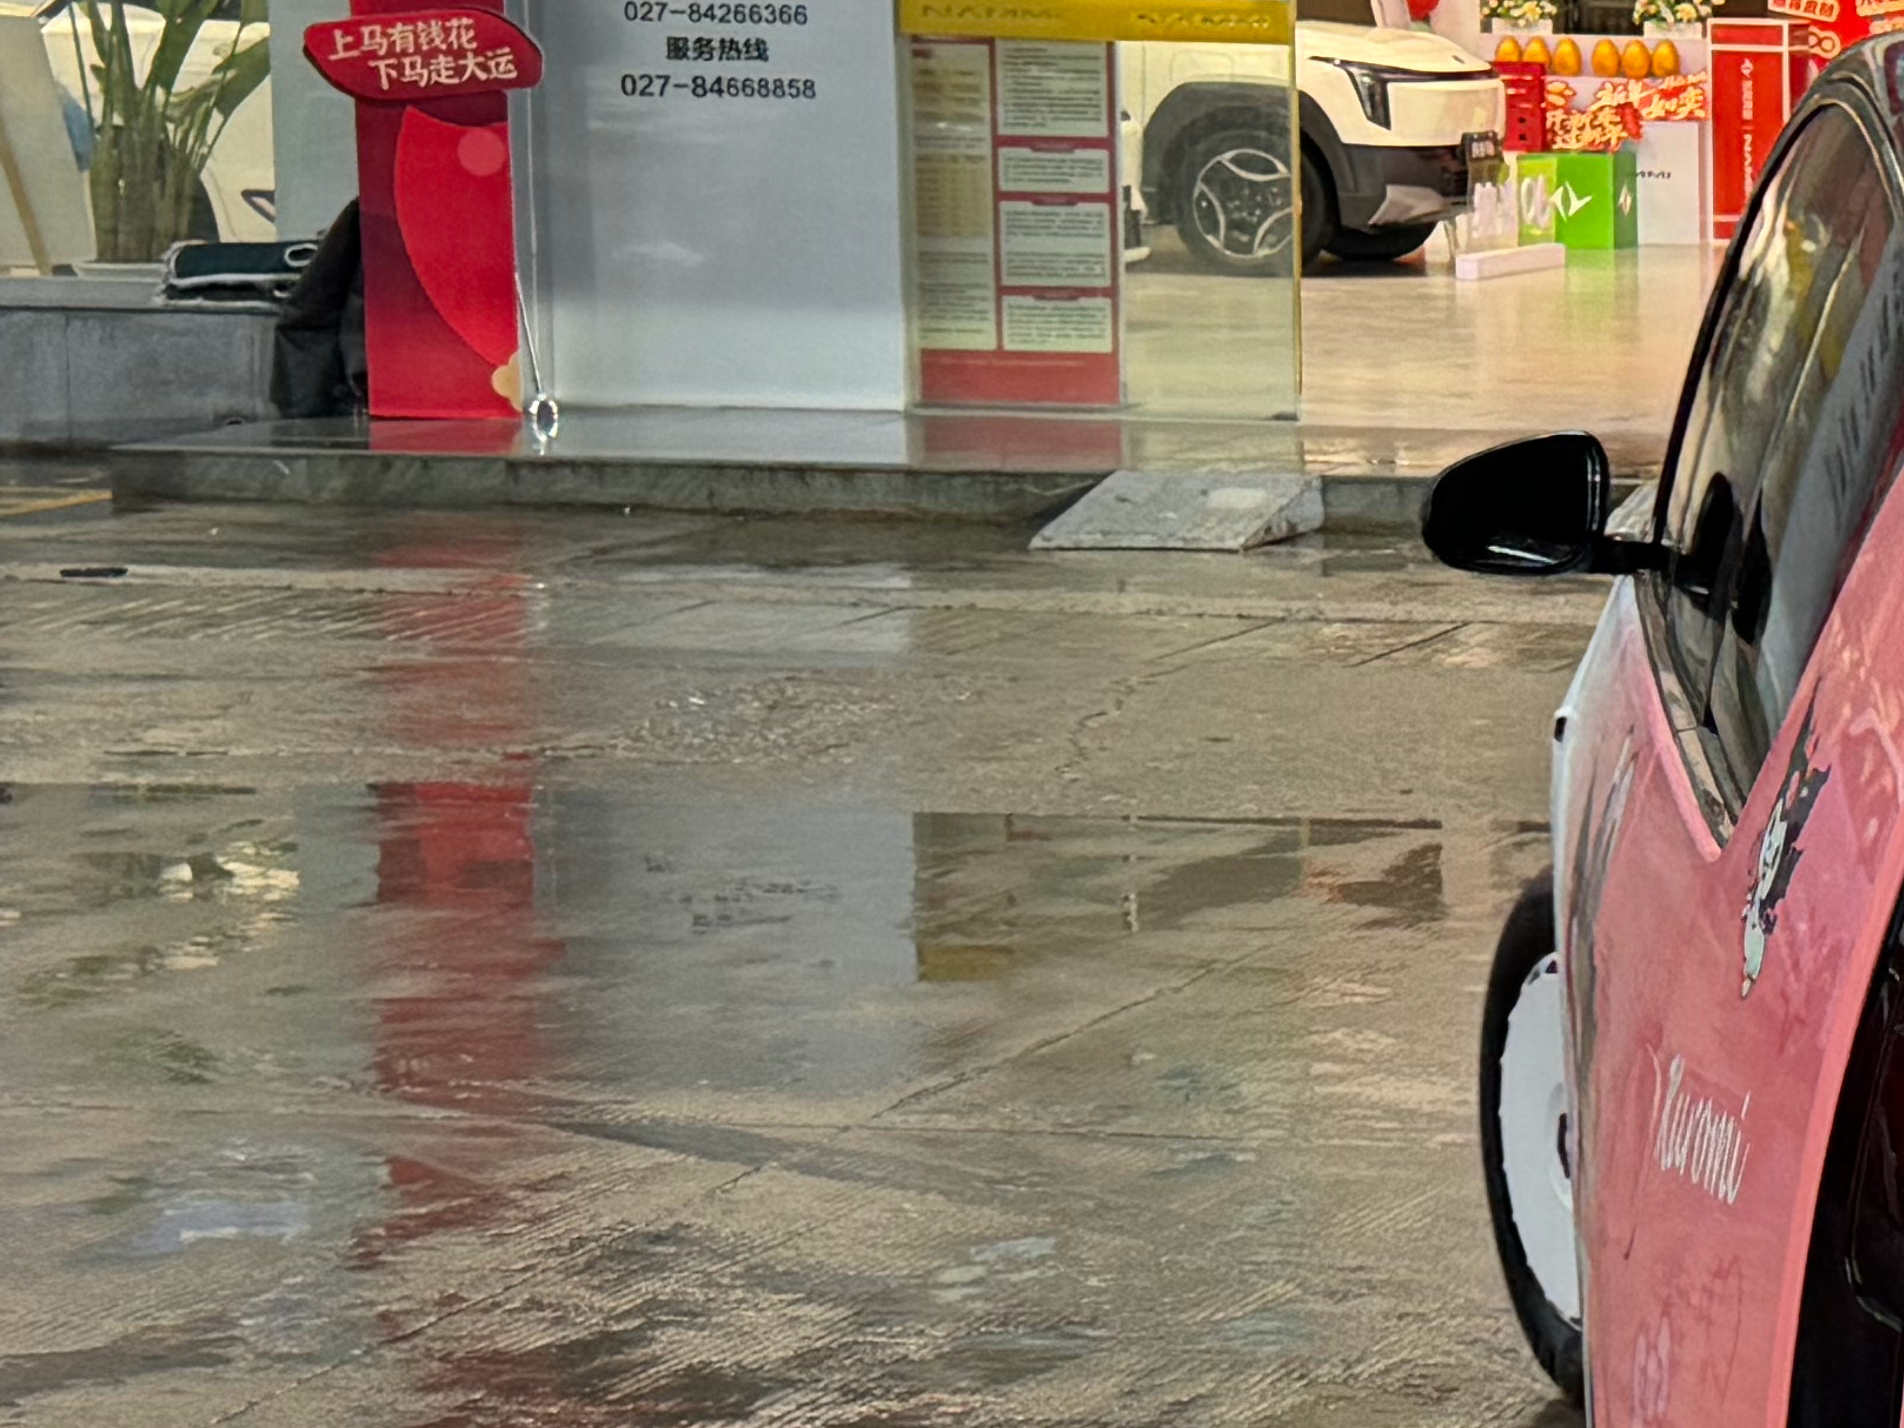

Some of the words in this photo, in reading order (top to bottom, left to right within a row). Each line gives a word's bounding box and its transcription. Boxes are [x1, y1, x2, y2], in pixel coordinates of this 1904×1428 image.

[328, 18, 477, 60] 上马有钱花
[666, 37, 769, 62] 服务热线
[369, 47, 518, 91] 下马走大运
